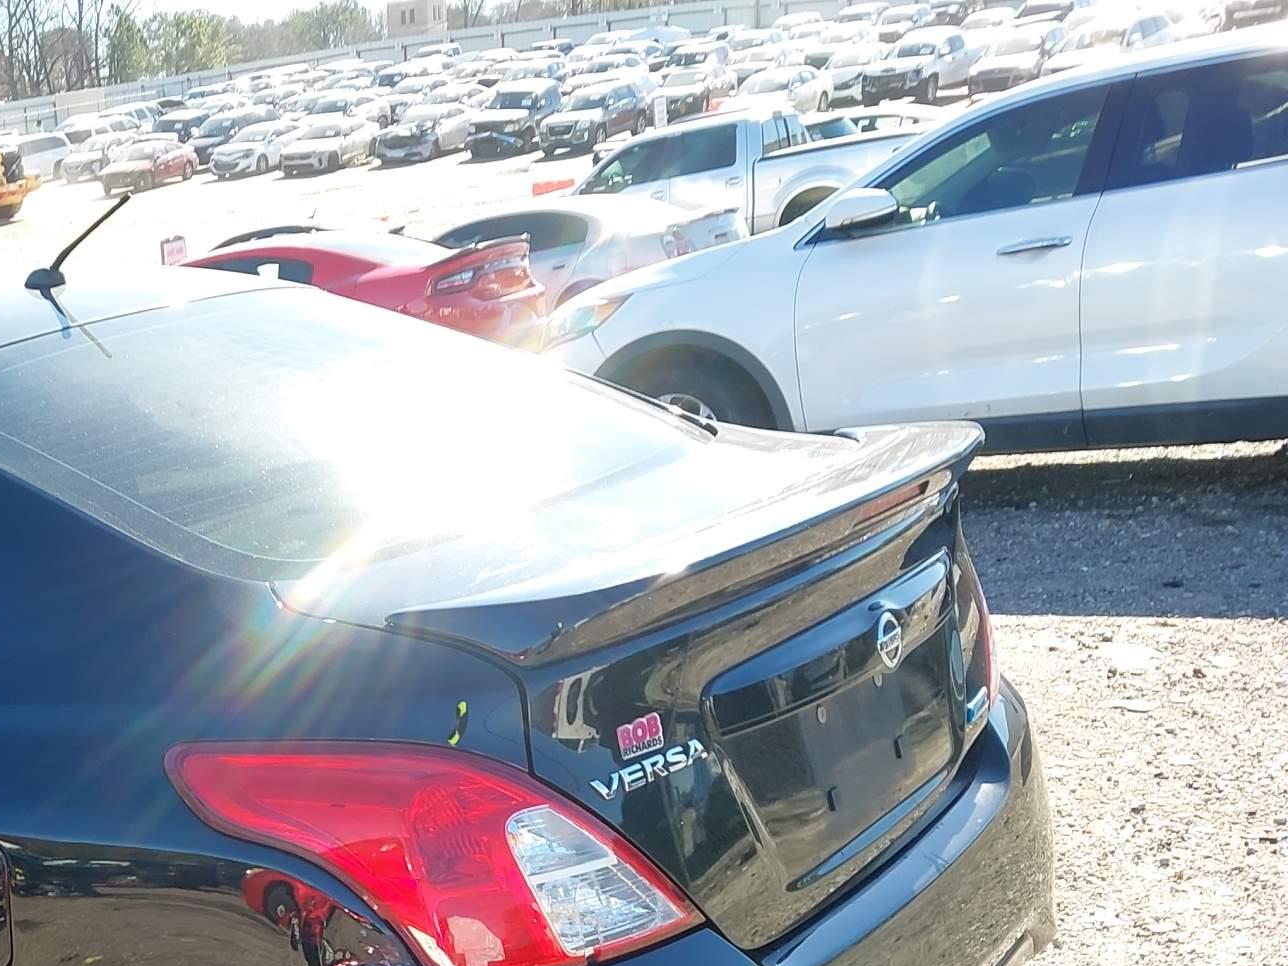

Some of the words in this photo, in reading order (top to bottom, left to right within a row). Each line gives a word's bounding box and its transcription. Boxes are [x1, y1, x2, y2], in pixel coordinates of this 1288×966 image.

[619, 714, 661, 747] BOB
[622, 735, 663, 757] RICHARDS
[589, 738, 708, 800] VERSA
